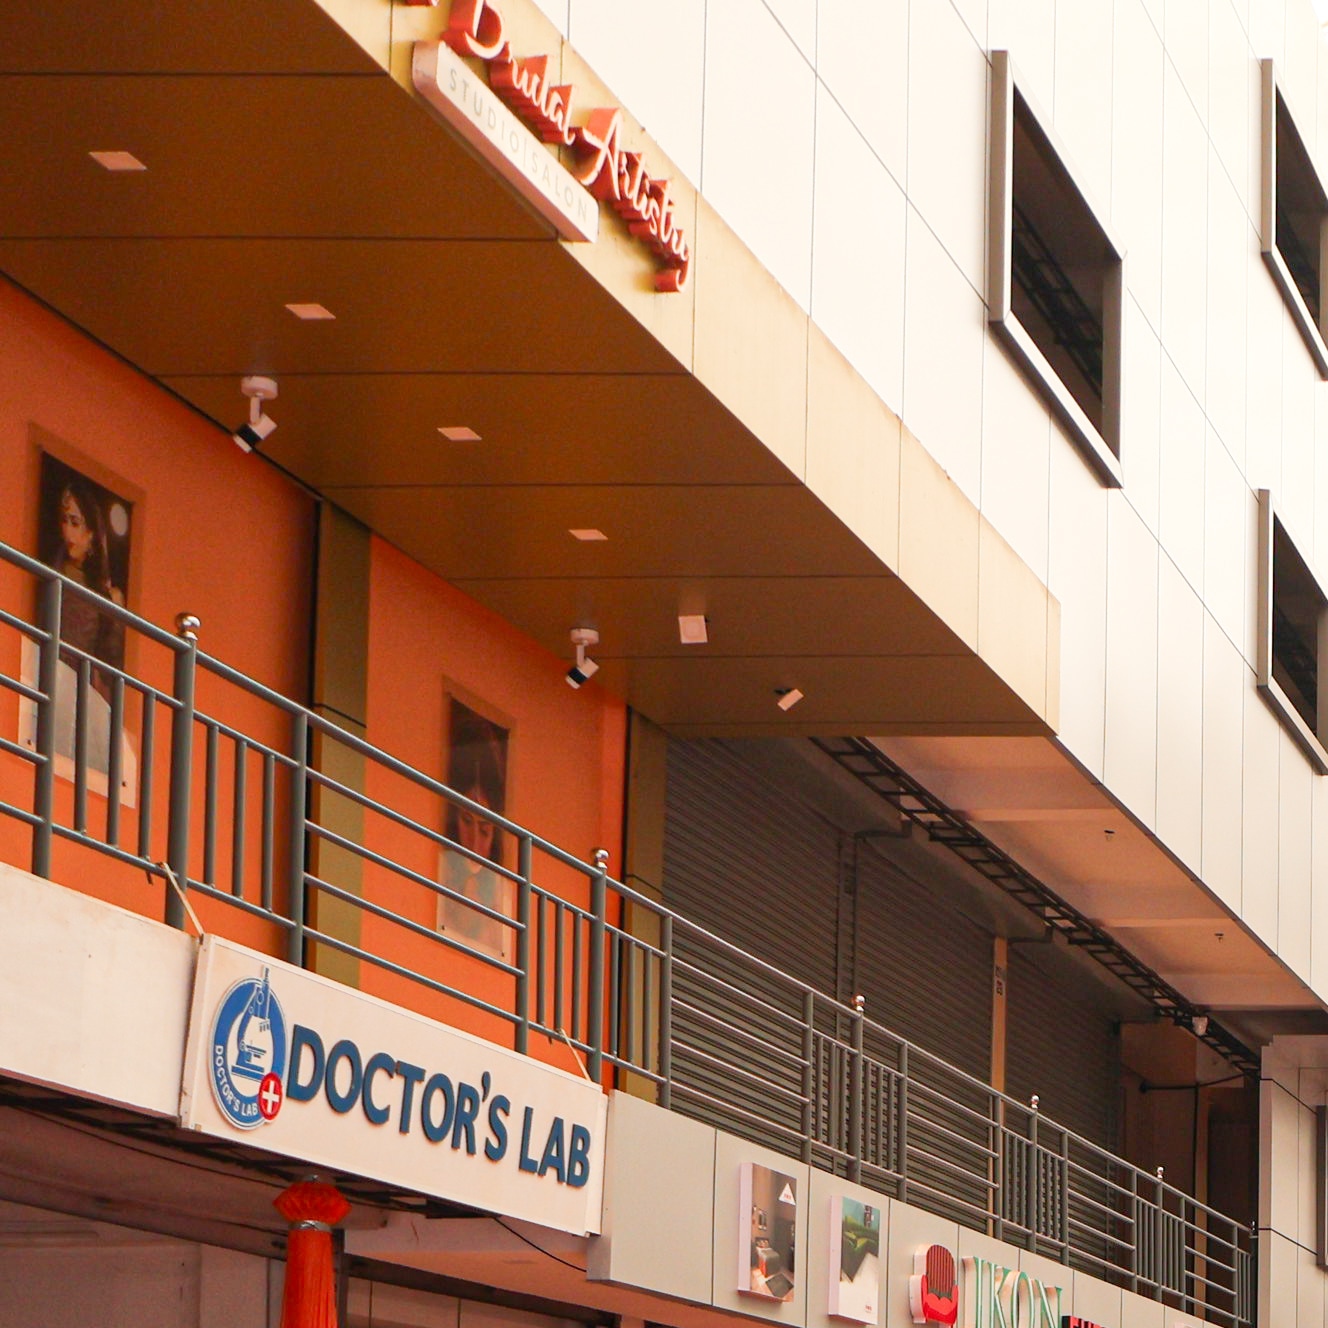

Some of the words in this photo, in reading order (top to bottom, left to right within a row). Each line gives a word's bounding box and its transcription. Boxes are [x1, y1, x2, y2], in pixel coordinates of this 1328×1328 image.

[239, 1101, 259, 1118] LAB
[286, 1023, 511, 1161] DOCTOR'S
[519, 1106, 592, 1188] LAB
